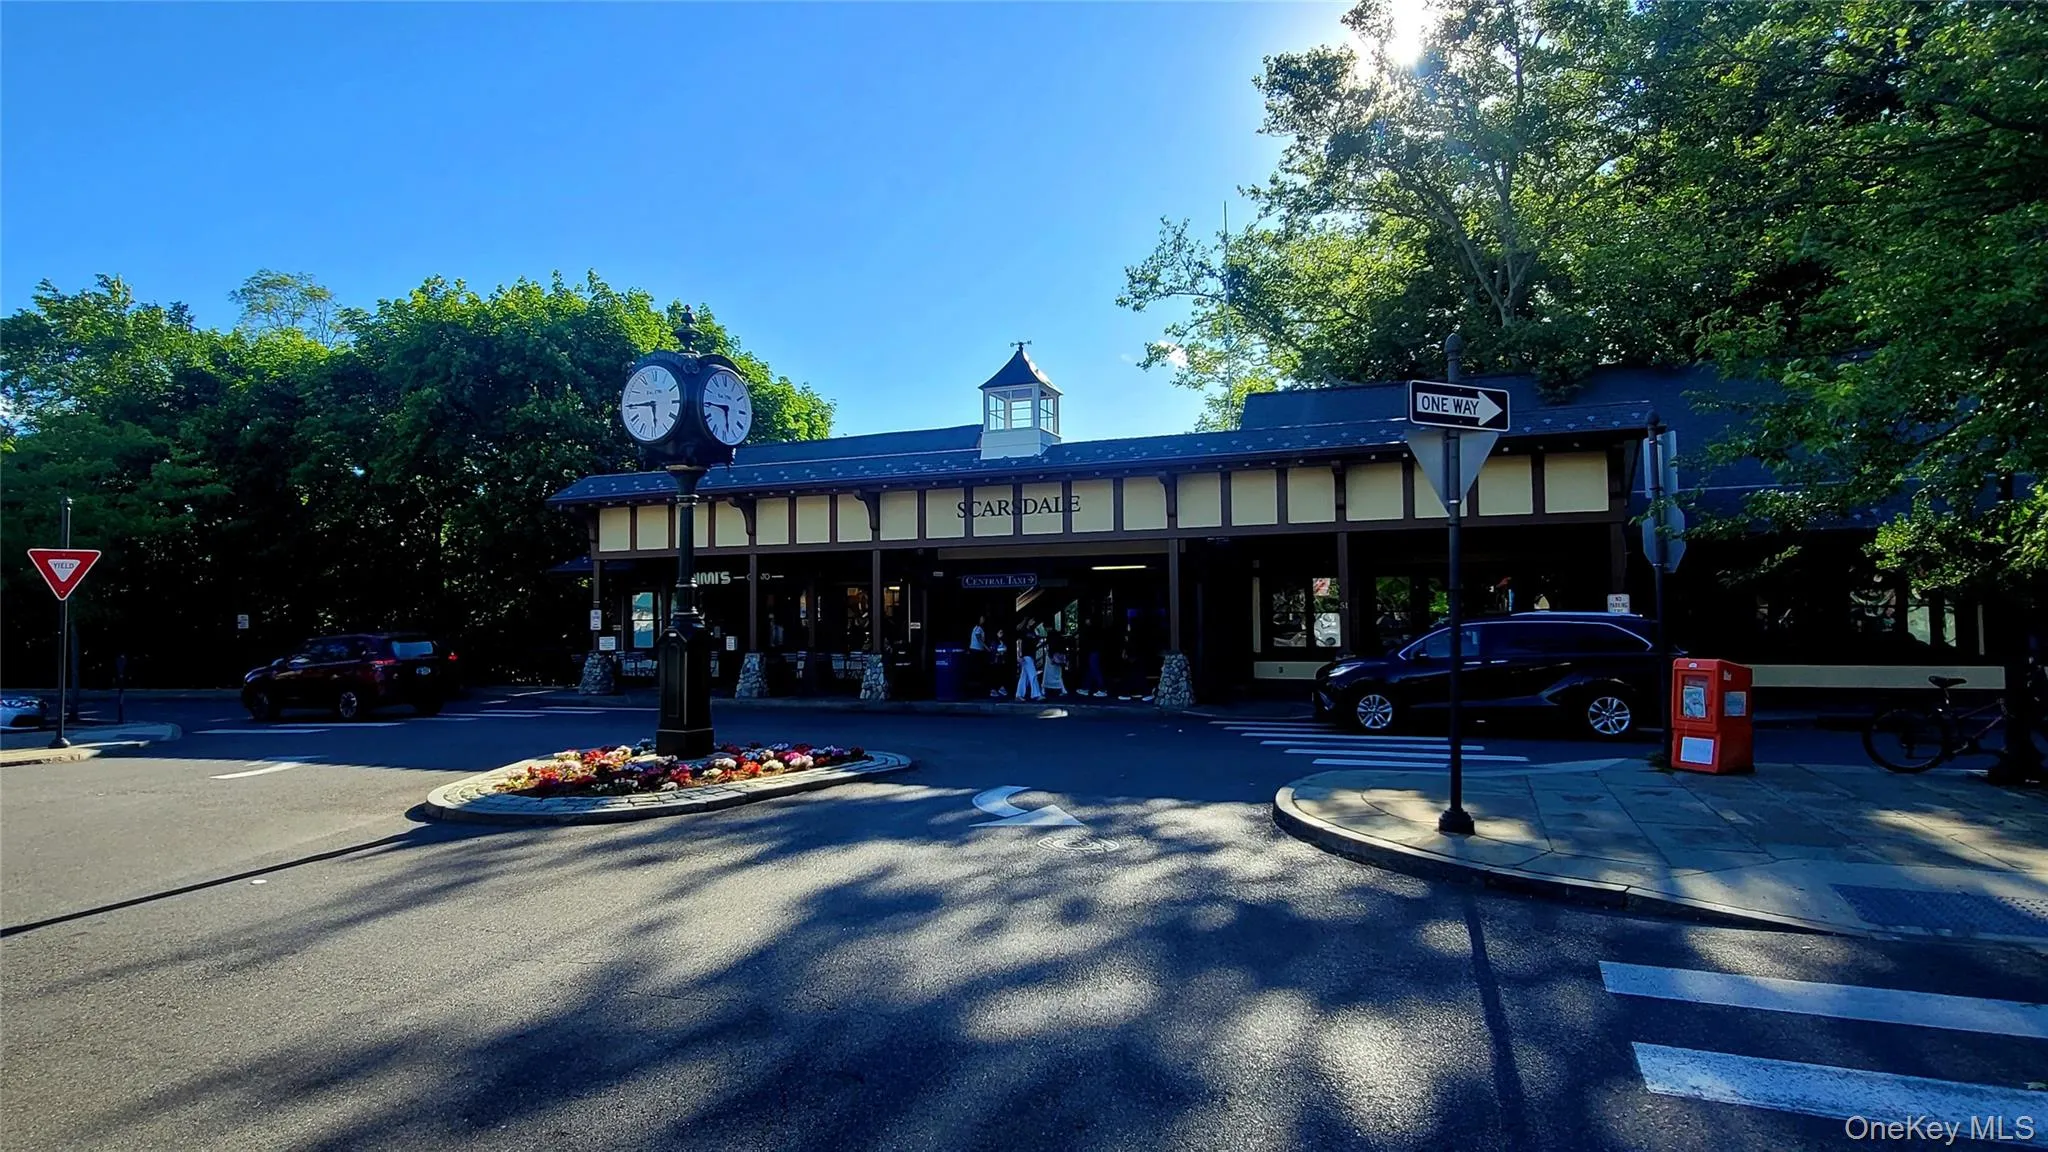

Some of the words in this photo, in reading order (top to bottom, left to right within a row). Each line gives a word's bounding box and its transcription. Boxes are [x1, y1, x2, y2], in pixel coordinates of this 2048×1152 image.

[1422, 395, 1449, 412] ONE
[1452, 398, 1479, 415] WAY
[957, 496, 1081, 518] SCARSDALE
